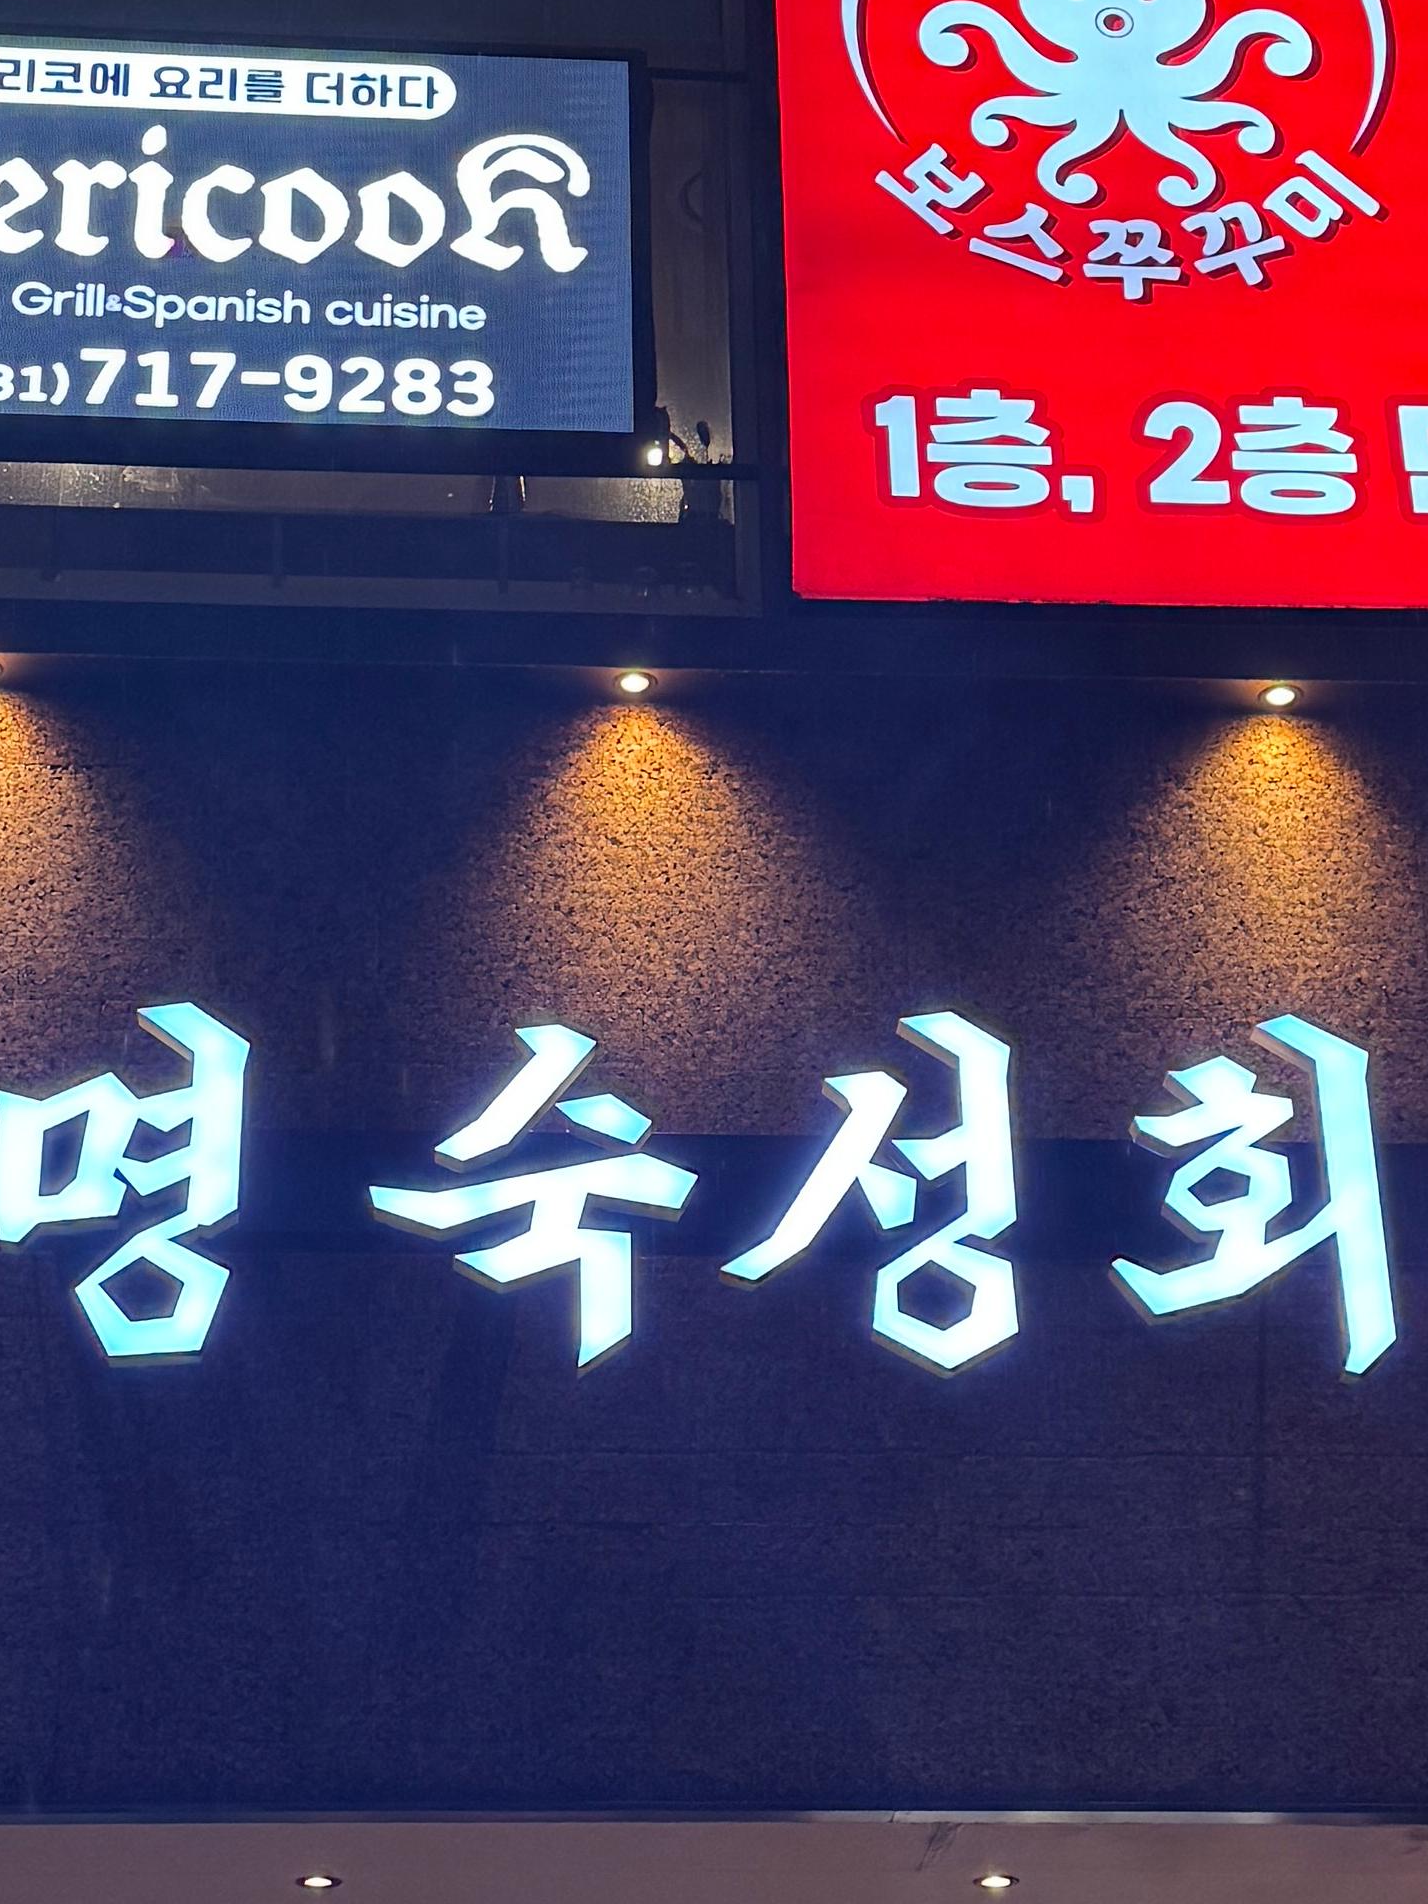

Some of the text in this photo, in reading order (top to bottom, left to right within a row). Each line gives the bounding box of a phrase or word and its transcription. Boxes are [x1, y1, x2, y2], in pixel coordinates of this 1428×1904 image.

[153, 64, 286, 105] 요리를
[304, 73, 441, 111] 더하다
[874, 142, 1384, 301] 보스쭈꾸미
[324, 288, 487, 332] cuisine
[874, 388, 1095, 516] 1층,
[1142, 396, 1358, 518] 2층
